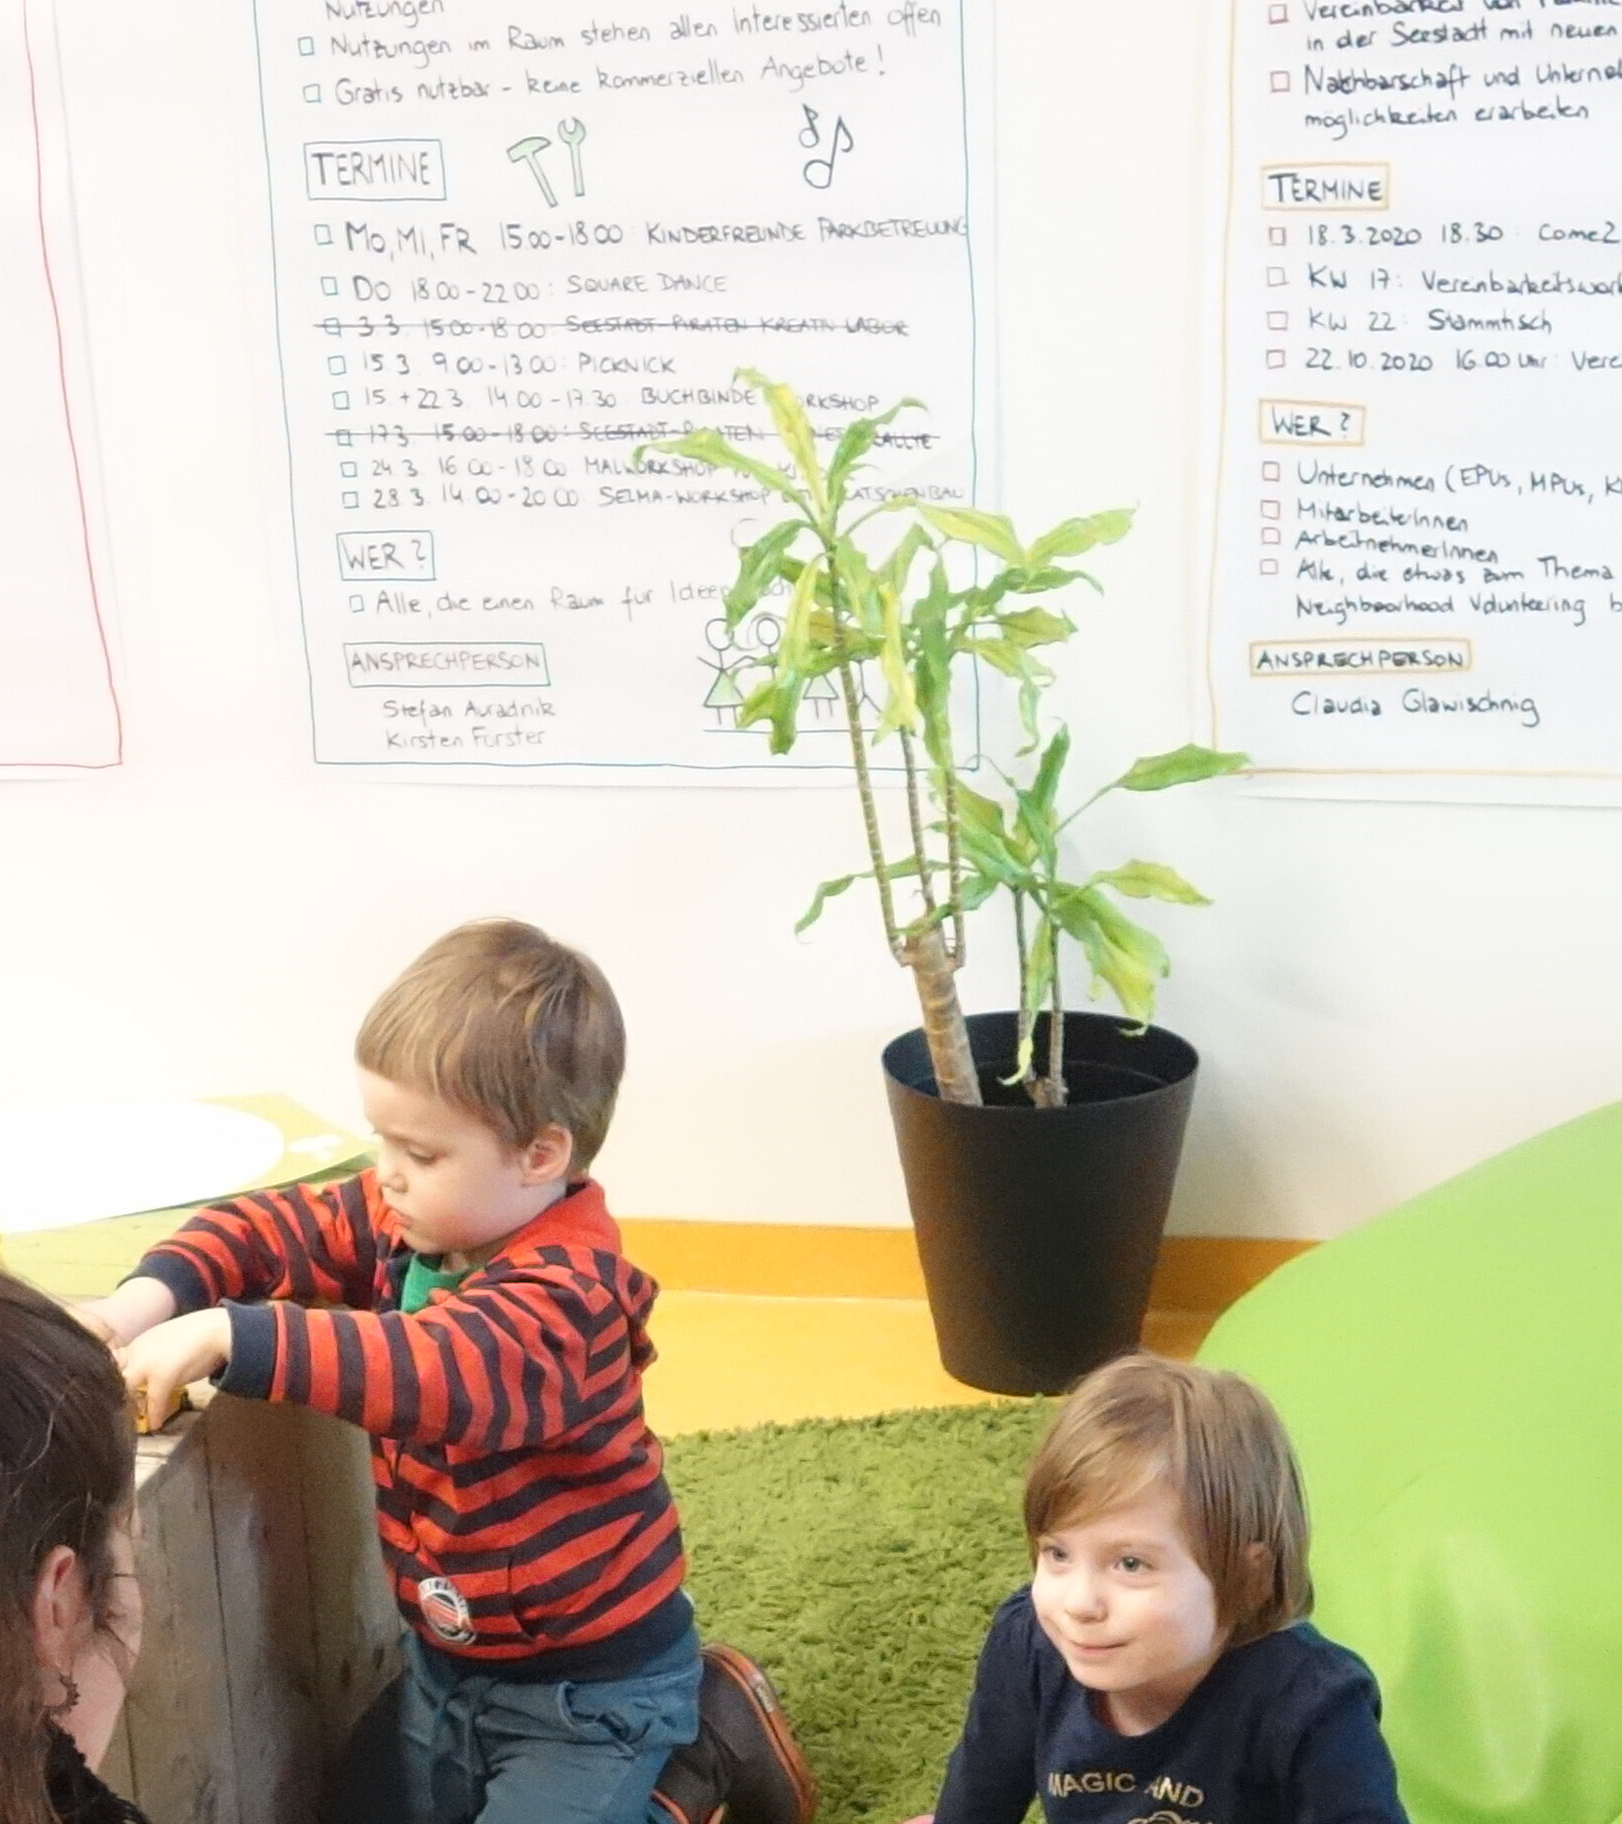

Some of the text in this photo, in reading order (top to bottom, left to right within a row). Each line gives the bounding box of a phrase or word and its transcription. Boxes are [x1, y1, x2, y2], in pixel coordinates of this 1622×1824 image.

[330, 33, 451, 69] Nutzungen
[468, 40, 490, 51] im
[508, 25, 565, 51] Raum
[580, 21, 650, 46] stehen
[670, 15, 717, 40] allen
[733, 0, 871, 33] Interessierten
[1306, 36, 1325, 51] in
[1335, 29, 1377, 50] der
[1390, 16, 1488, 48] Seestadt
[1499, 19, 1534, 41] mit
[1549, 22, 1618, 40] neuen
[335, 77, 403, 106] Gratis
[417, 77, 490, 100] nutzbar
[525, 70, 581, 94] keine
[596, 59, 744, 89] kommerziellen
[1483, 65, 1521, 88] und
[311, 151, 430, 186] TERMINE
[1268, 171, 1383, 203] TERMINE
[646, 221, 805, 245] KINDERFREUNDE
[567, 275, 648, 294] SQUARE
[657, 272, 726, 292] DANCE
[1307, 262, 1348, 290] KW
[1308, 307, 1347, 332] KW
[579, 351, 676, 374] PICKNICK
[640, 387, 756, 408] BUCHBINDE
[1297, 459, 1435, 493] Unternehmen
[1536, 554, 1615, 581] Thema
[550, 586, 604, 610] Raum
[351, 651, 540, 672] ANSPRECHPERSON
[1256, 649, 1465, 672] ANSPRECHPERSON
[383, 699, 555, 727] Stefan Auradnik
[1291, 687, 1541, 729] Claudia Glawischnig
[387, 731, 462, 749] Kirsten
[1048, 1772, 1204, 1808] MAGIC AND
